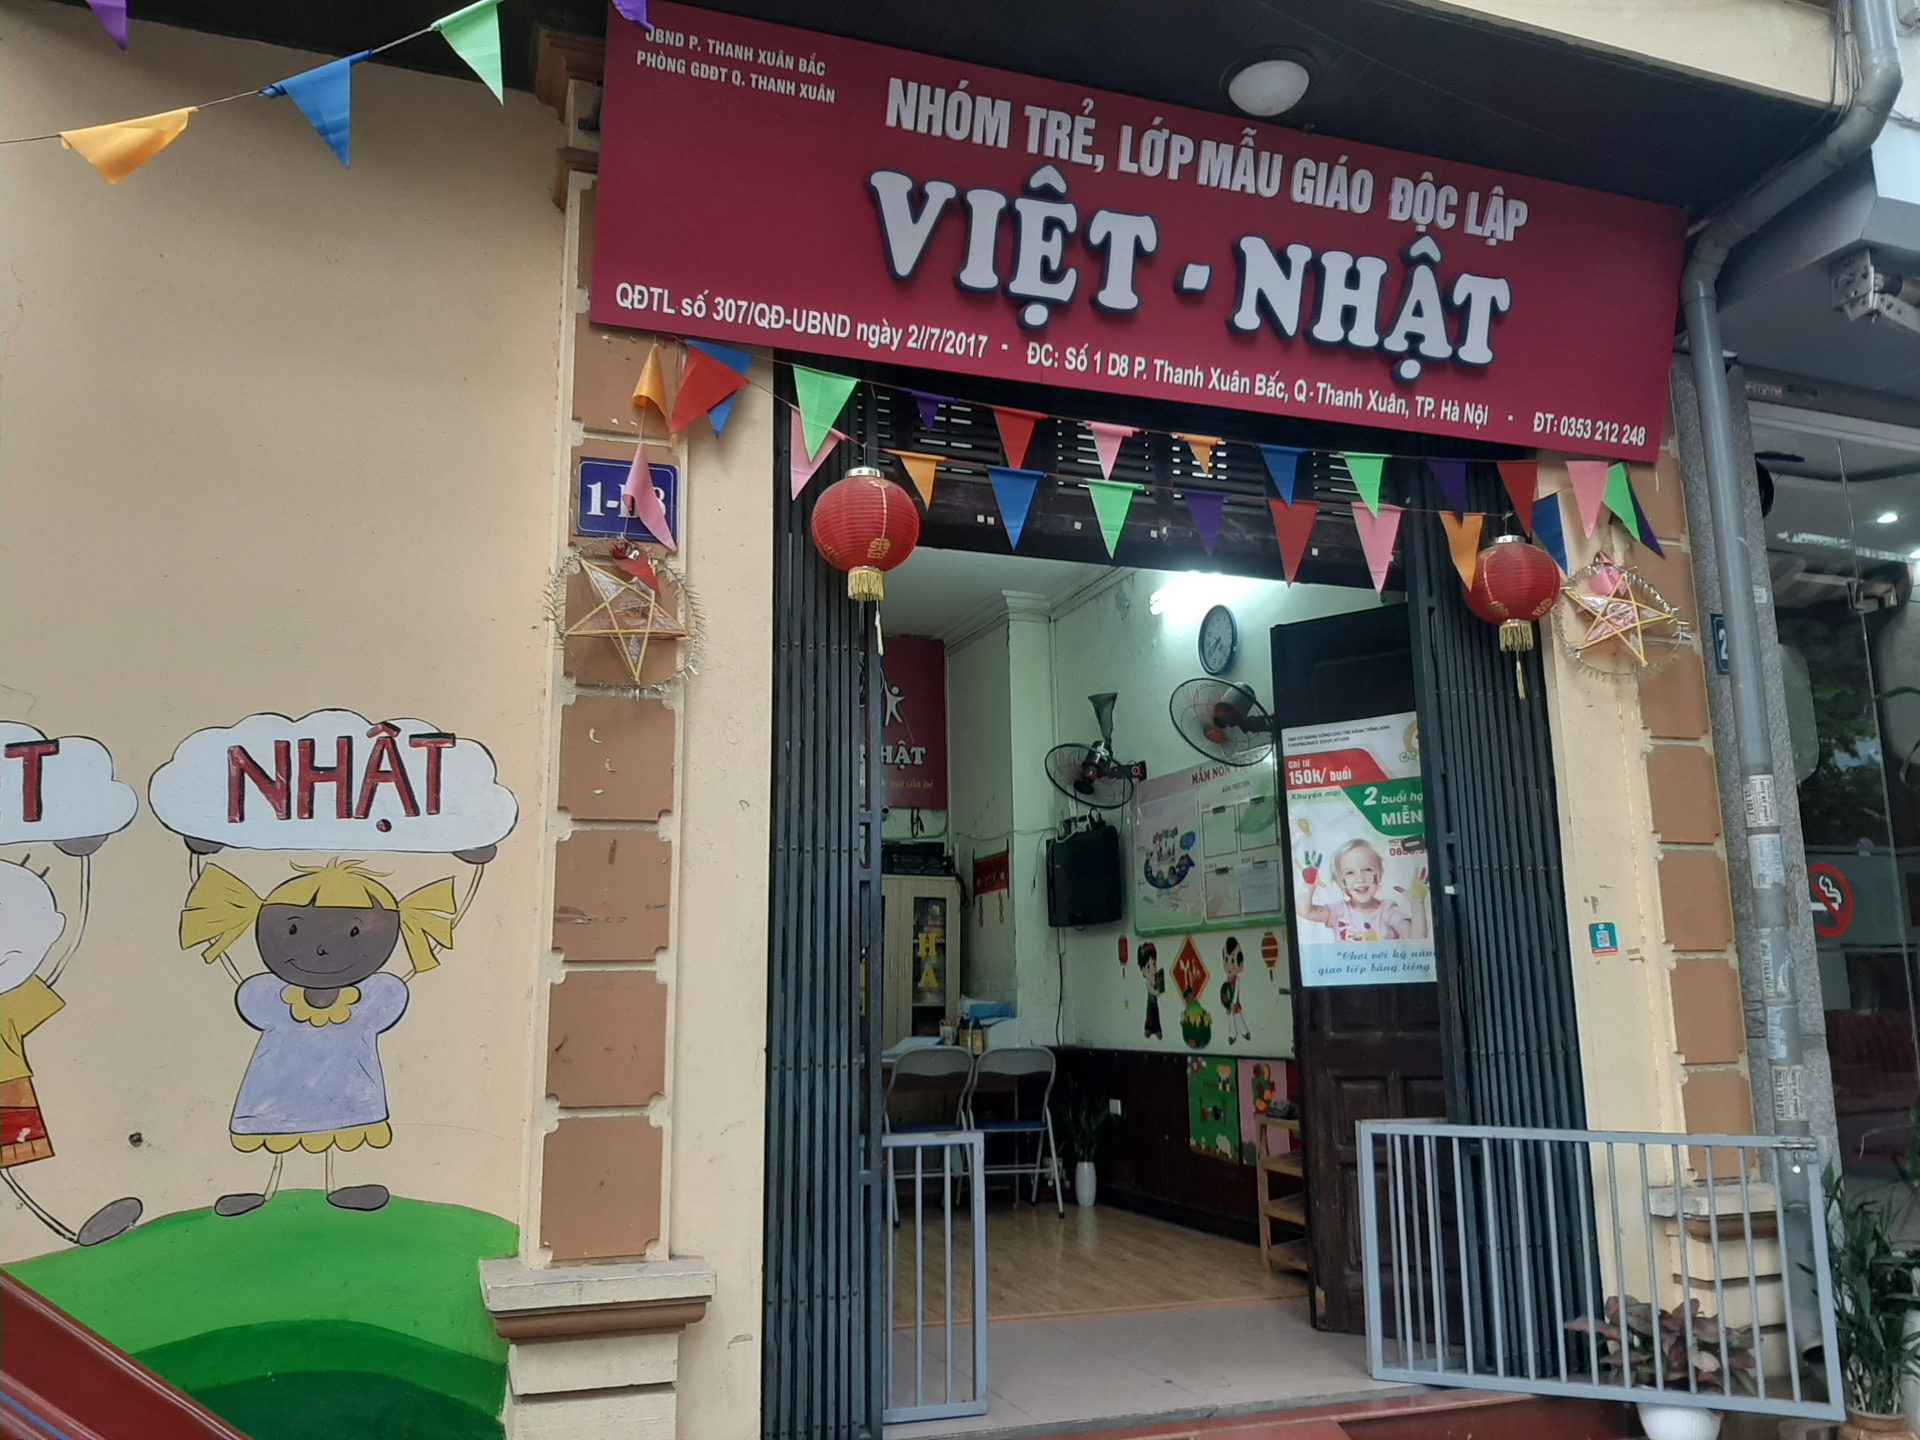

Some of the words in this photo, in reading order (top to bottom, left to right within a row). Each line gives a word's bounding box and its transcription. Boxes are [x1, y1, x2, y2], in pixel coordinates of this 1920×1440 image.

[636, 50, 686, 75] PHÒNG
[690, 62, 728, 83] GDĐT
[731, 70, 746, 87] Q.
[750, 73, 796, 96] THANH
[799, 83, 835, 104] XUÂN
[689, 35, 701, 52] P.
[707, 38, 753, 62] THANH
[757, 49, 794, 70] XUÂN
[798, 52, 826, 77] BẮC
[885, 77, 1011, 149] NHÓM
[1024, 98, 1105, 173] TRẺ,
[1117, 116, 1194, 180] LỚP
[1197, 127, 1283, 198] MẪU
[1290, 155, 1375, 214] GIÁO
[1388, 171, 1459, 232] ĐỘC
[1464, 185, 1529, 246] LẬP
[868, 163, 1158, 329] VIỆT
[1227, 234, 1512, 382] NHẬT
[616, 282, 675, 314] QĐTL
[681, 289, 709, 318] số
[712, 296, 851, 339] 307/QĐ-UBND
[857, 318, 903, 351] ngày
[1027, 341, 1059, 368] ĐC:
[1065, 343, 1089, 372] Số
[1093, 350, 1102, 375] 1
[1107, 352, 1129, 378] D8
[1134, 355, 1148, 381] P.
[1153, 358, 1204, 389] Thanh
[1208, 366, 1250, 395] Xuân
[1254, 370, 1289, 403] Bắc,
[1366, 389, 1410, 419] Xuân,
[1415, 395, 1436, 419] TP.
[1440, 398, 1460, 422] Hà
[1463, 402, 1489, 430] Nội
[1533, 411, 1558, 434] ĐT:
[1560, 415, 1592, 439] 0353
[1594, 420, 1619, 443] 212
[1622, 424, 1646, 447] 248
[227, 721, 456, 833] NHẬT
[1363, 786, 1378, 806] 2
[1381, 789, 1407, 804] buổi
[1381, 805, 1423, 826] MIỄN
[1318, 966, 1342, 976] giao
